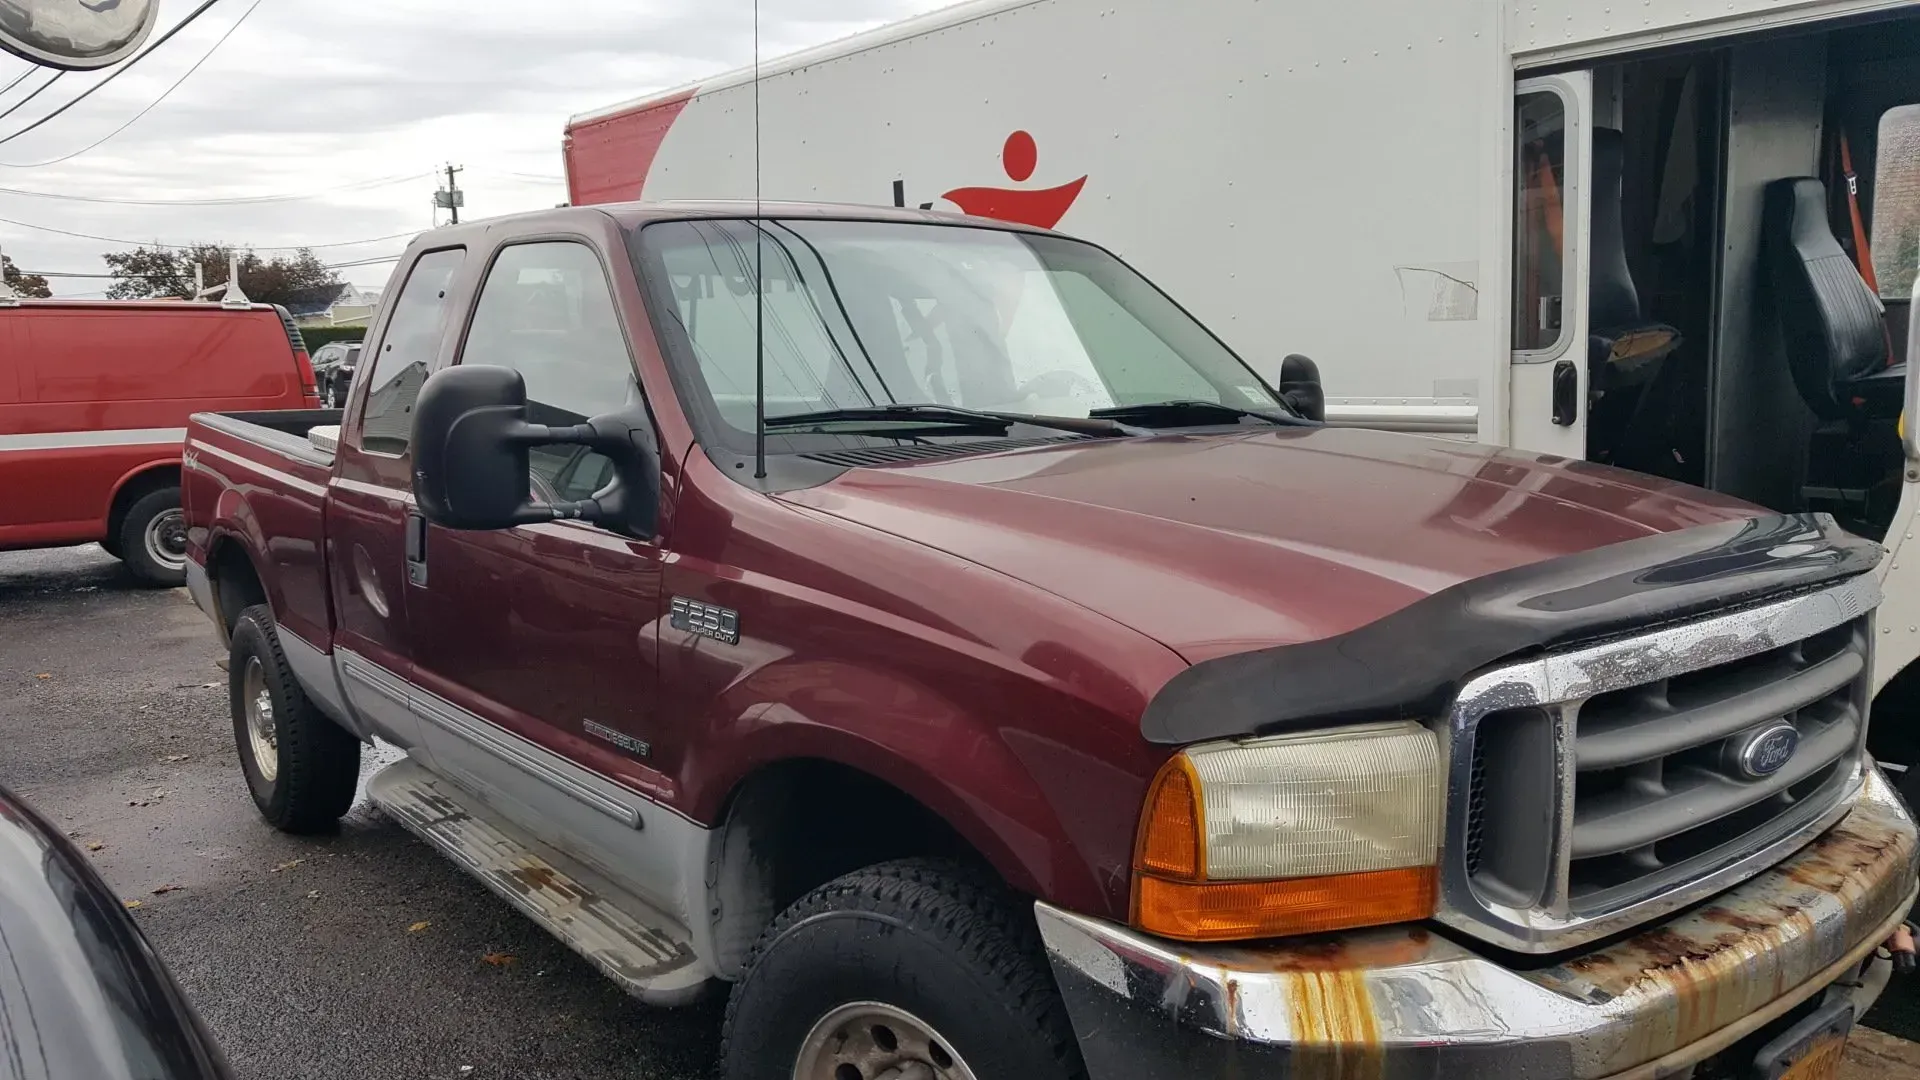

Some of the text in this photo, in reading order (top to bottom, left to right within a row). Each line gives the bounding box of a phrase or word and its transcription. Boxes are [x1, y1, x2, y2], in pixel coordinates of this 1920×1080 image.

[690, 625, 735, 643] SUPER DUTY
[1761, 736, 1790, 768] Ford
